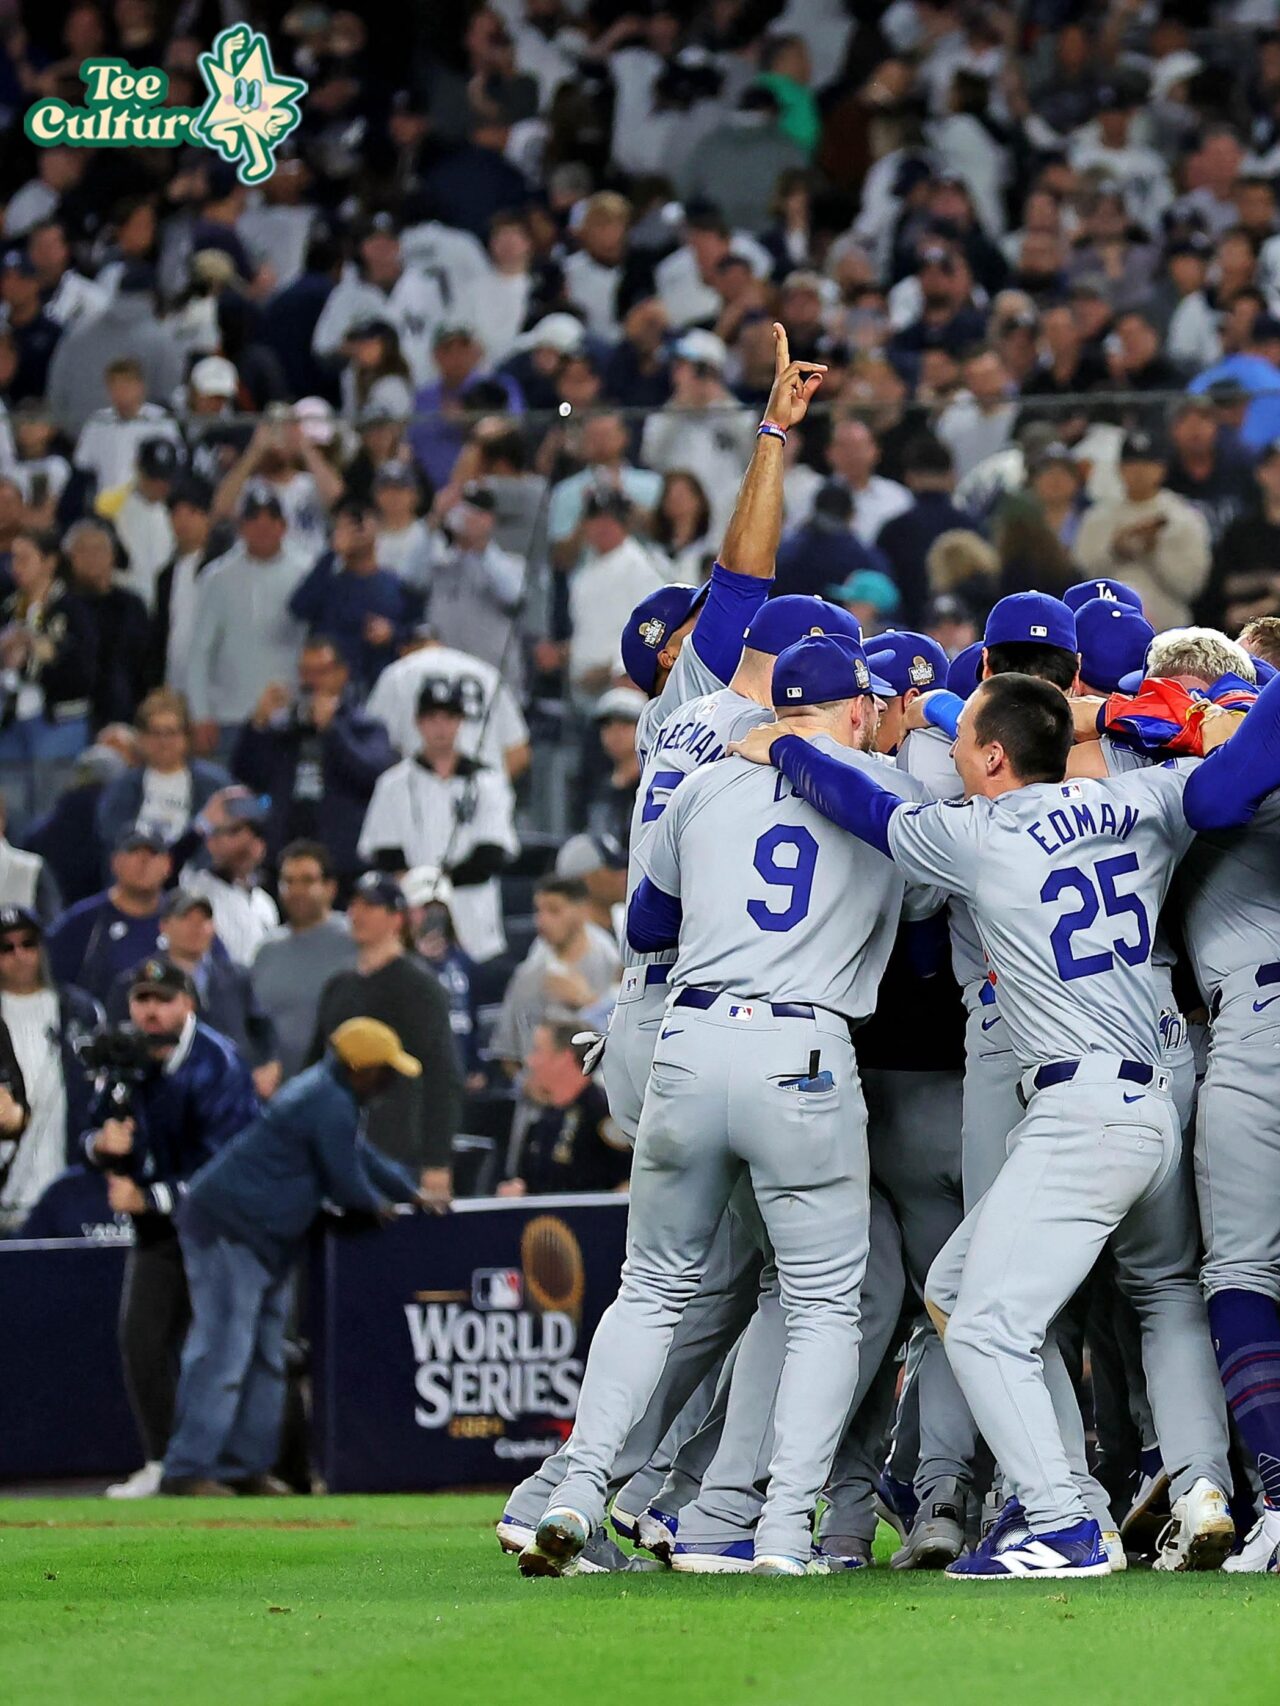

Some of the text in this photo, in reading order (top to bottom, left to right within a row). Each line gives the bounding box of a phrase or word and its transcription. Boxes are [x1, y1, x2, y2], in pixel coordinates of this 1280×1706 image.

[1027, 803, 1139, 855] EDMAN
[746, 823, 820, 933] 9
[1039, 851, 1151, 982] 25
[403, 1303, 578, 1364] WORLD
[414, 1357, 585, 1430] SERIES
